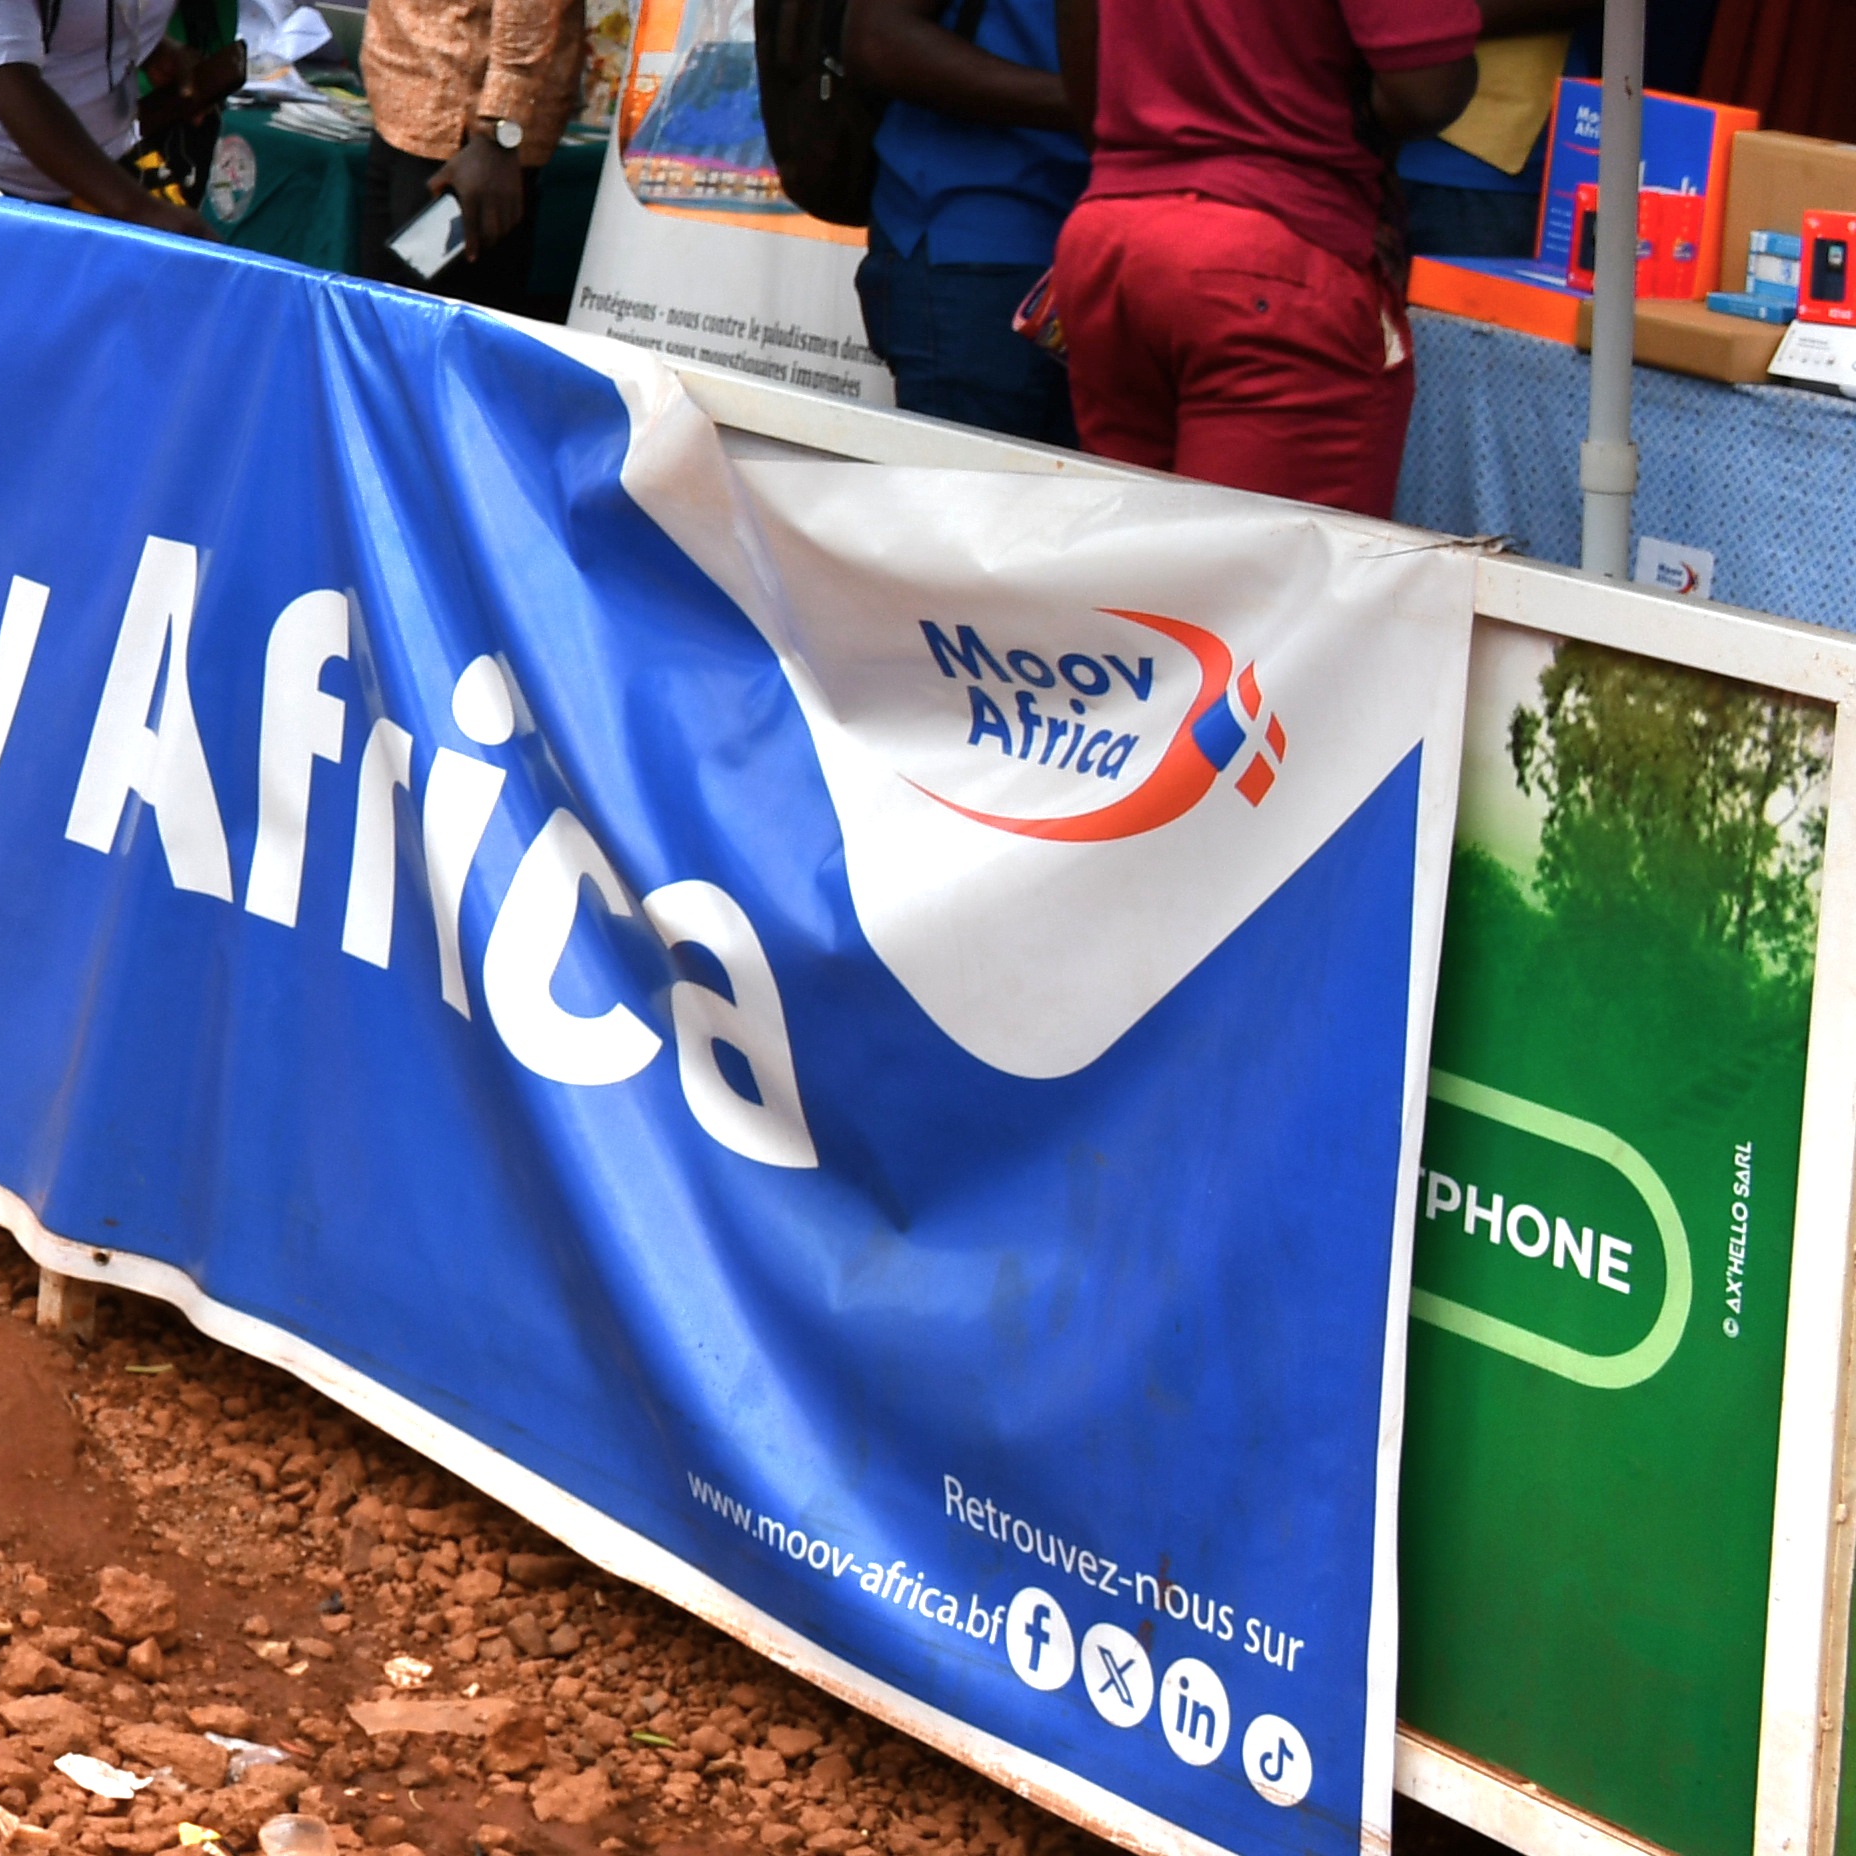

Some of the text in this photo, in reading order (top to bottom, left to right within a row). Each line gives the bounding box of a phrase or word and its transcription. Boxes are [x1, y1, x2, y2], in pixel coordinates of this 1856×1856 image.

[579, 286, 657, 322] Protégeons
[666, 306, 701, 334] nous
[701, 311, 747, 341] contre
[747, 317, 761, 342] le
[918, 620, 1155, 702] Moov
[966, 686, 1140, 781] Africa
[65, 536, 820, 1171] Africa
[1733, 1140, 1754, 1197] SARL
[1725, 1200, 1751, 1314] AX'HELLO
[687, 1470, 1008, 1647] www.moov-africa.bf
[943, 1472, 1306, 1673] Retrouvez-nous sur
